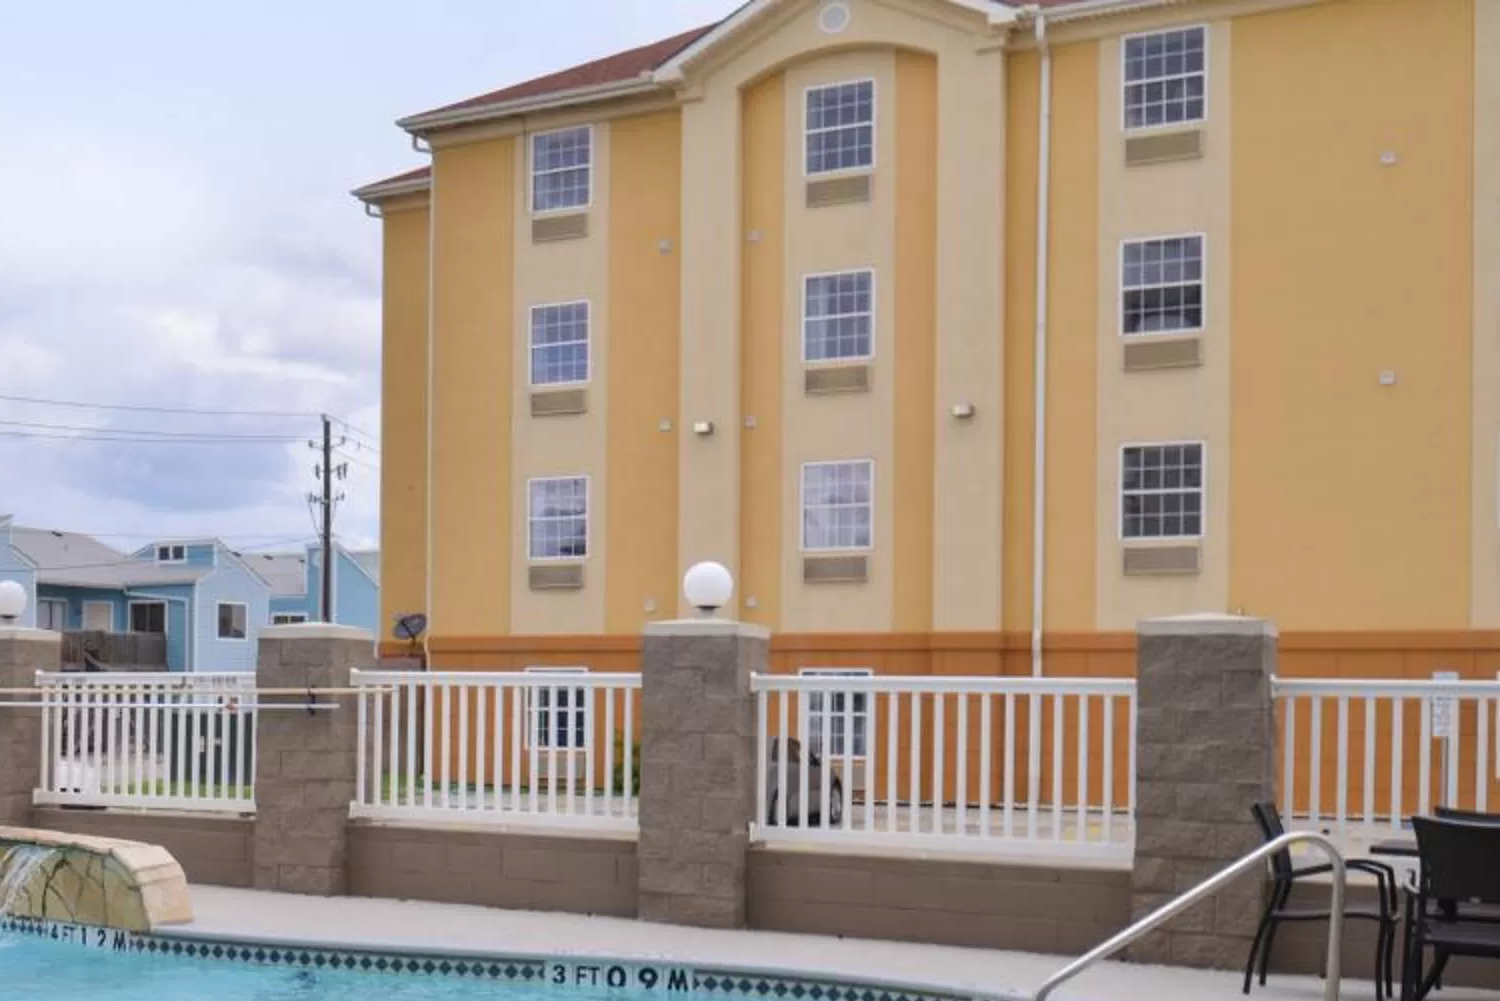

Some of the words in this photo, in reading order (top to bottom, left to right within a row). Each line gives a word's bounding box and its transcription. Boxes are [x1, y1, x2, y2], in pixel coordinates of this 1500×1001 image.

[113, 930, 127, 951] M
[552, 964, 566, 985] 3
[575, 965, 600, 986] FT
[667, 967, 689, 993] M
